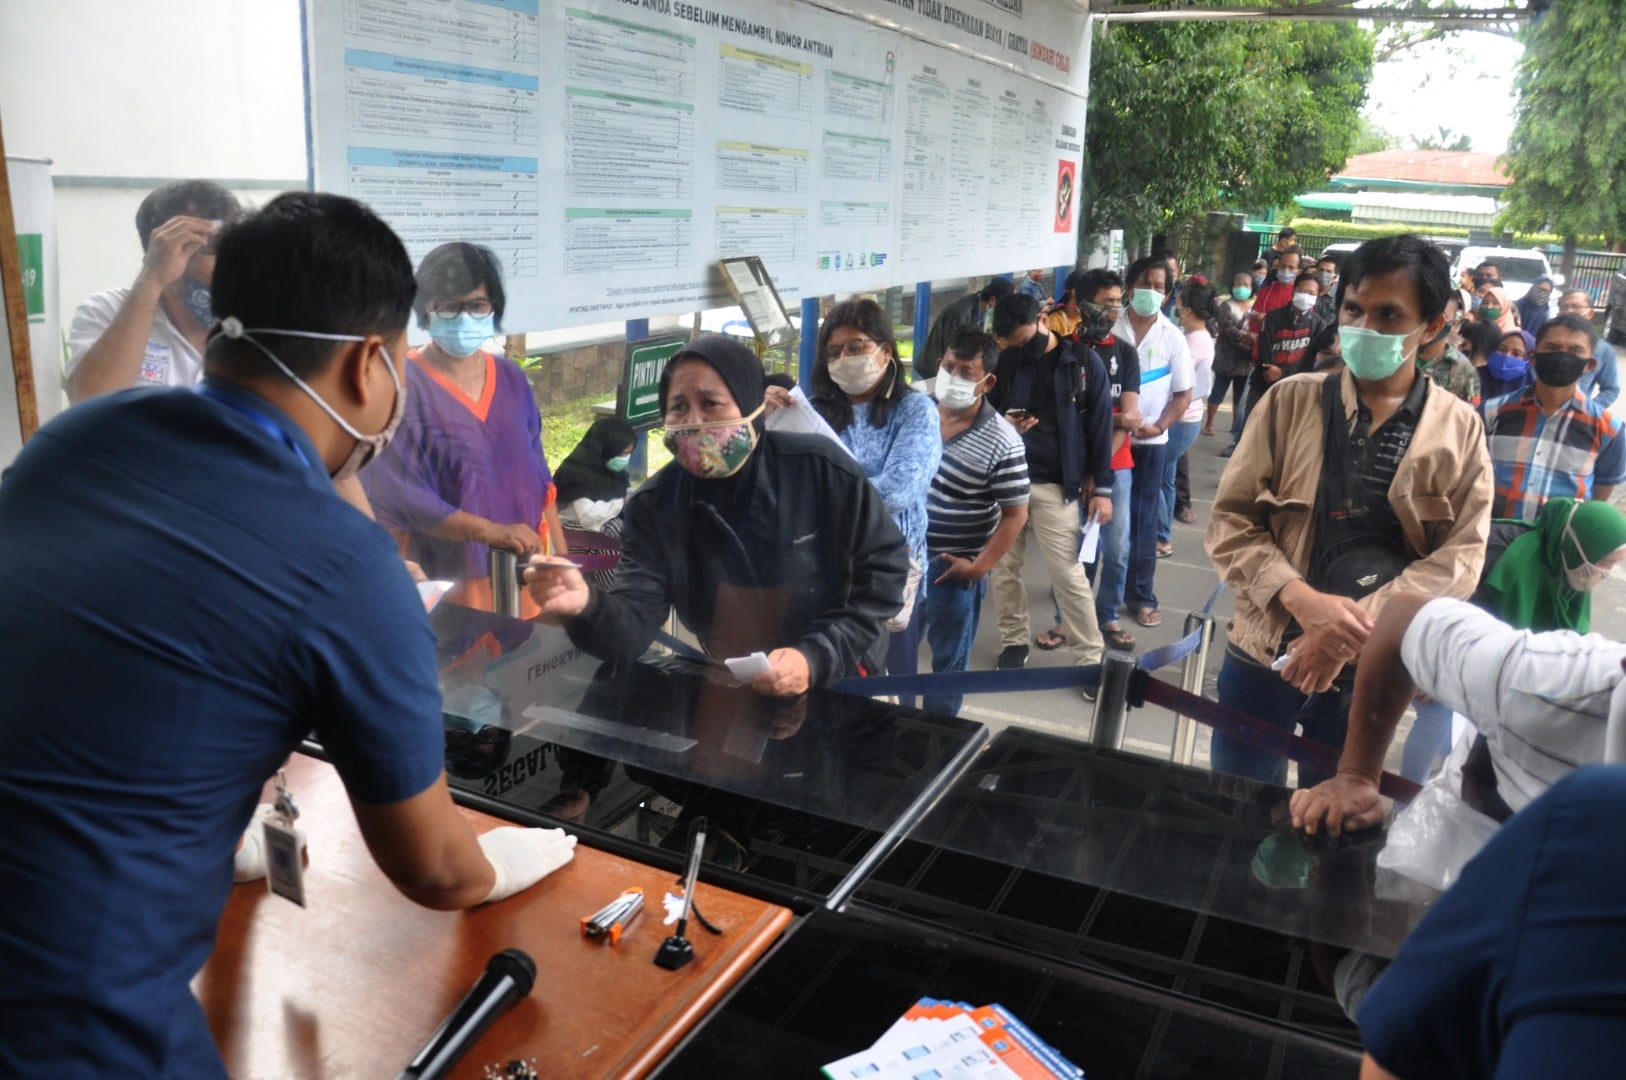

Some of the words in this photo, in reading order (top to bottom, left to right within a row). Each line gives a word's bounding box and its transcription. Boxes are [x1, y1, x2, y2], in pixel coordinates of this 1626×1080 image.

[673, 1, 720, 28] SEBELUM
[721, 15, 774, 44] MENGAMBIL
[775, 30, 801, 50] NOMOR
[803, 37, 834, 59] ANTRIAN
[918, 0, 942, 22] TIDAK
[944, 5, 984, 37] DIKENAKAN
[632, 359, 656, 389] PINTU
